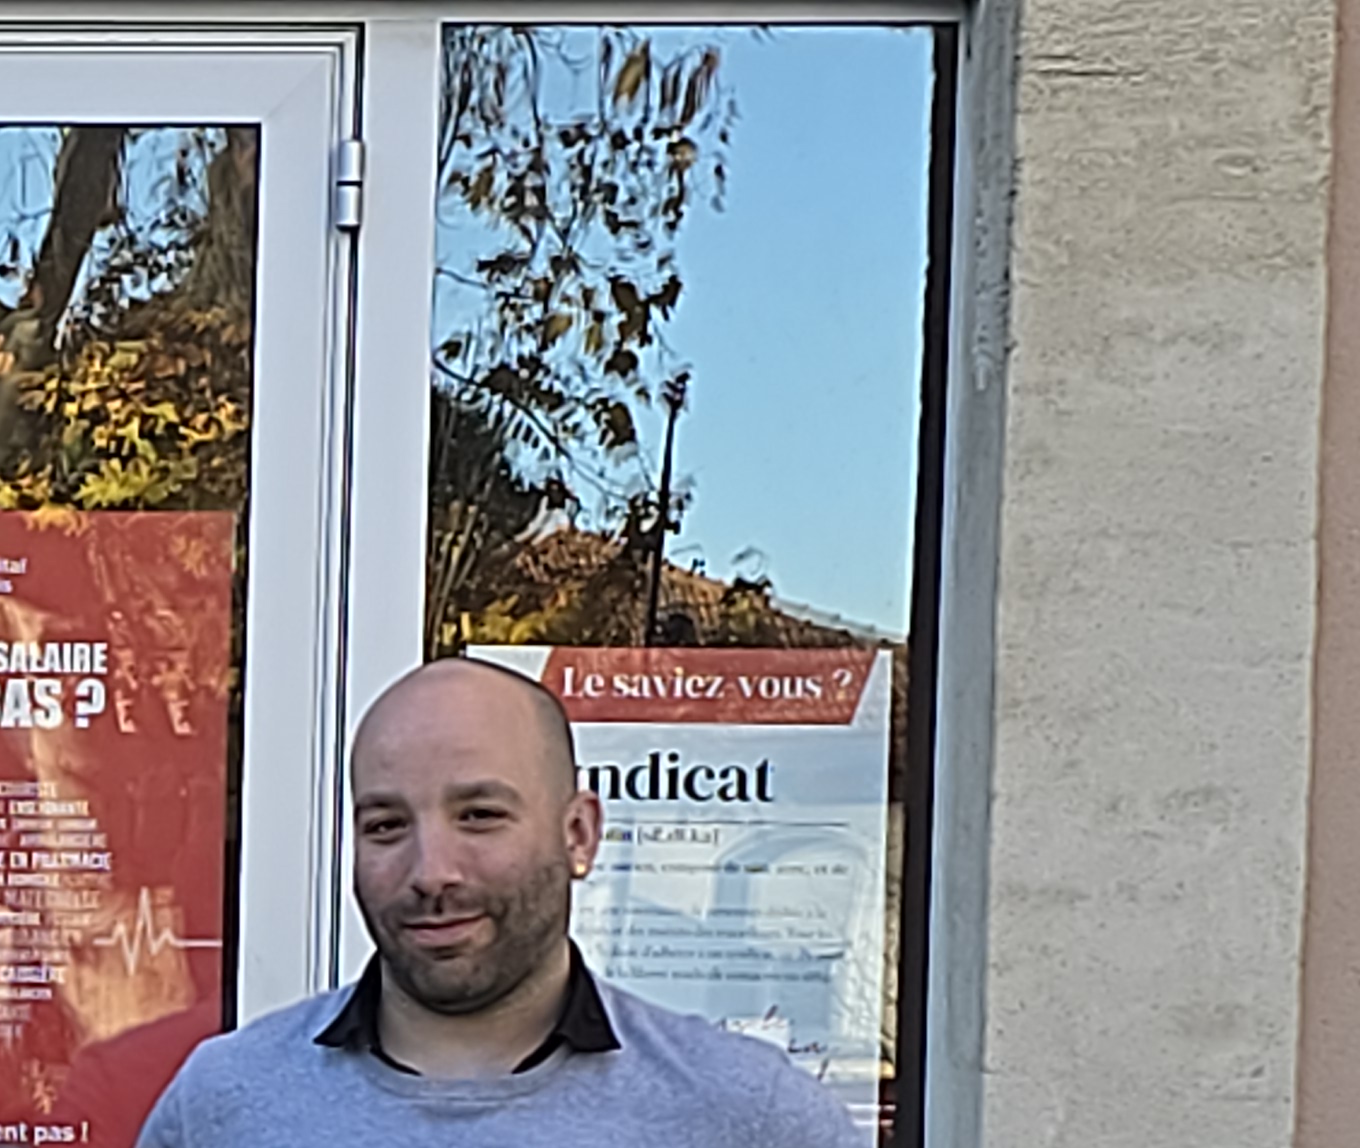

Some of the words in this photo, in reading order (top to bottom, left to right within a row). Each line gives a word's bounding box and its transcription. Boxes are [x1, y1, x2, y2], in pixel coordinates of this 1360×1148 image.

[563, 666, 605, 697] Le
[75, 679, 107, 728] ?
[575, 752, 776, 802] ndicat
[34, 1125, 75, 1146] pas
